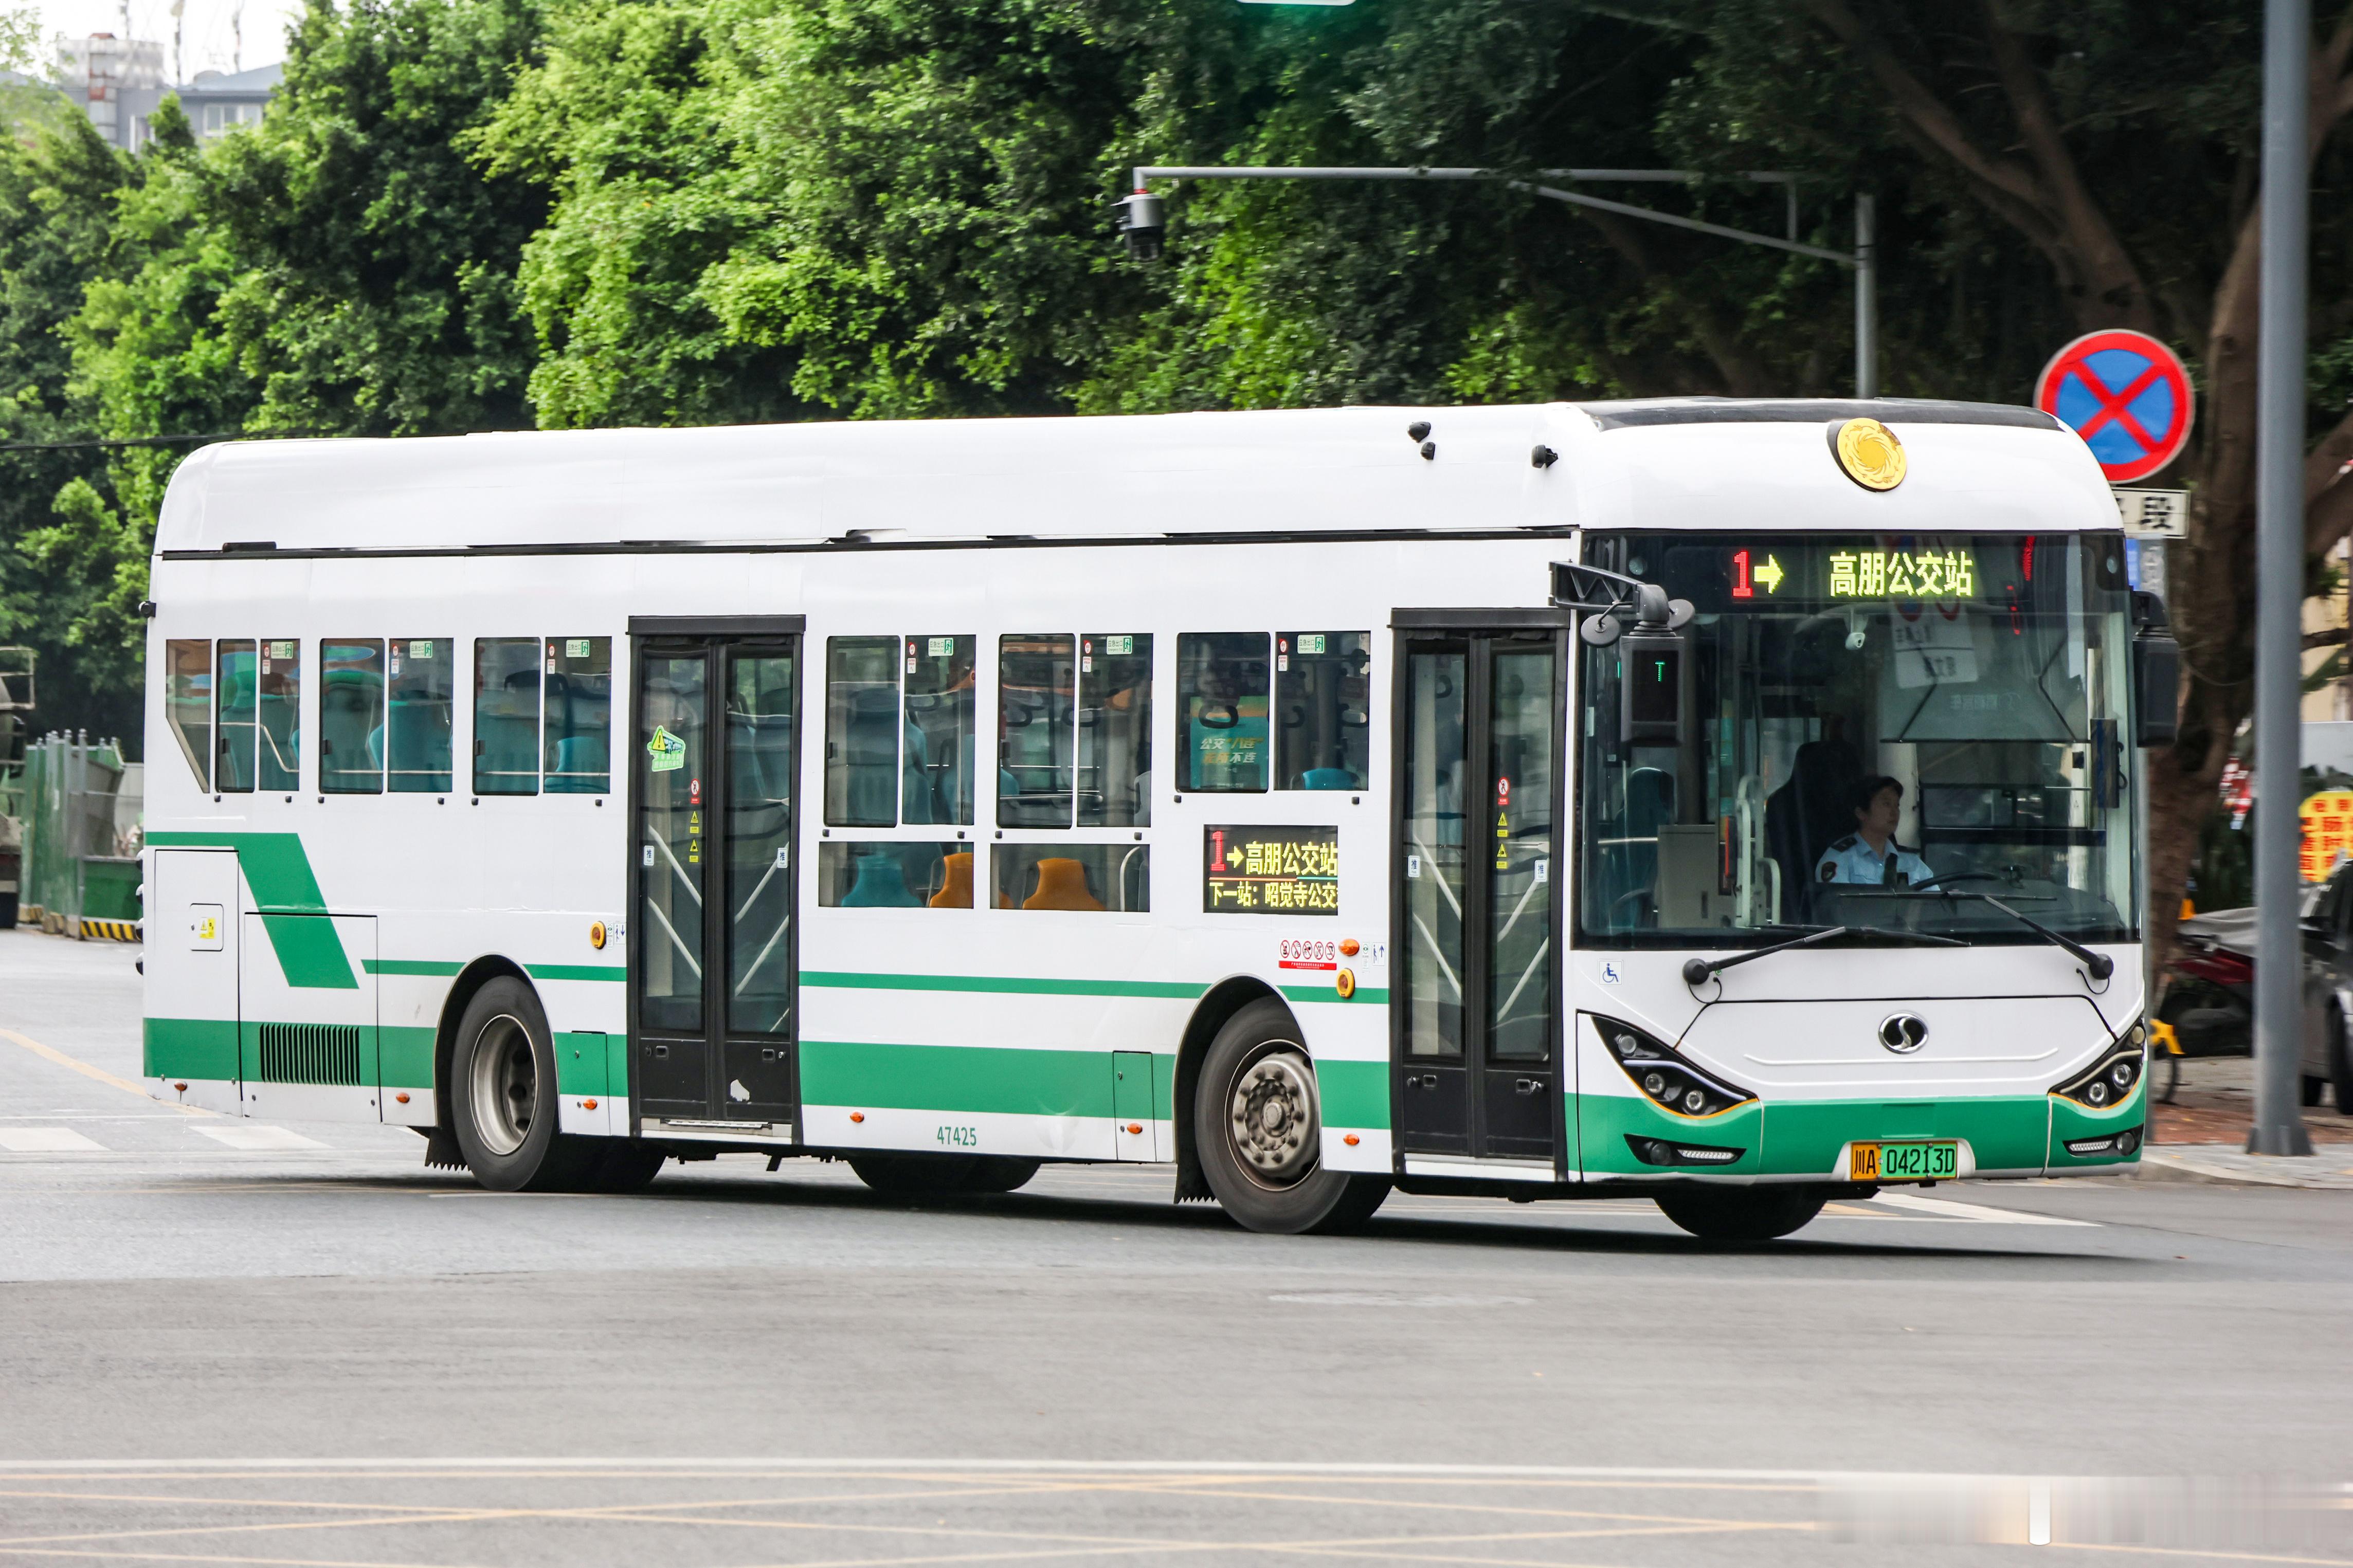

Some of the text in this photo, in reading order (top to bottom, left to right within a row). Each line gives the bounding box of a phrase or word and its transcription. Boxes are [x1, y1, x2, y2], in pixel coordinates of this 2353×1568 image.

[1732, 550, 1974, 597] 1 高朋公交站
[1210, 830, 1338, 876] 1 高朋公交站
[936, 1125, 977, 1147] 47425
